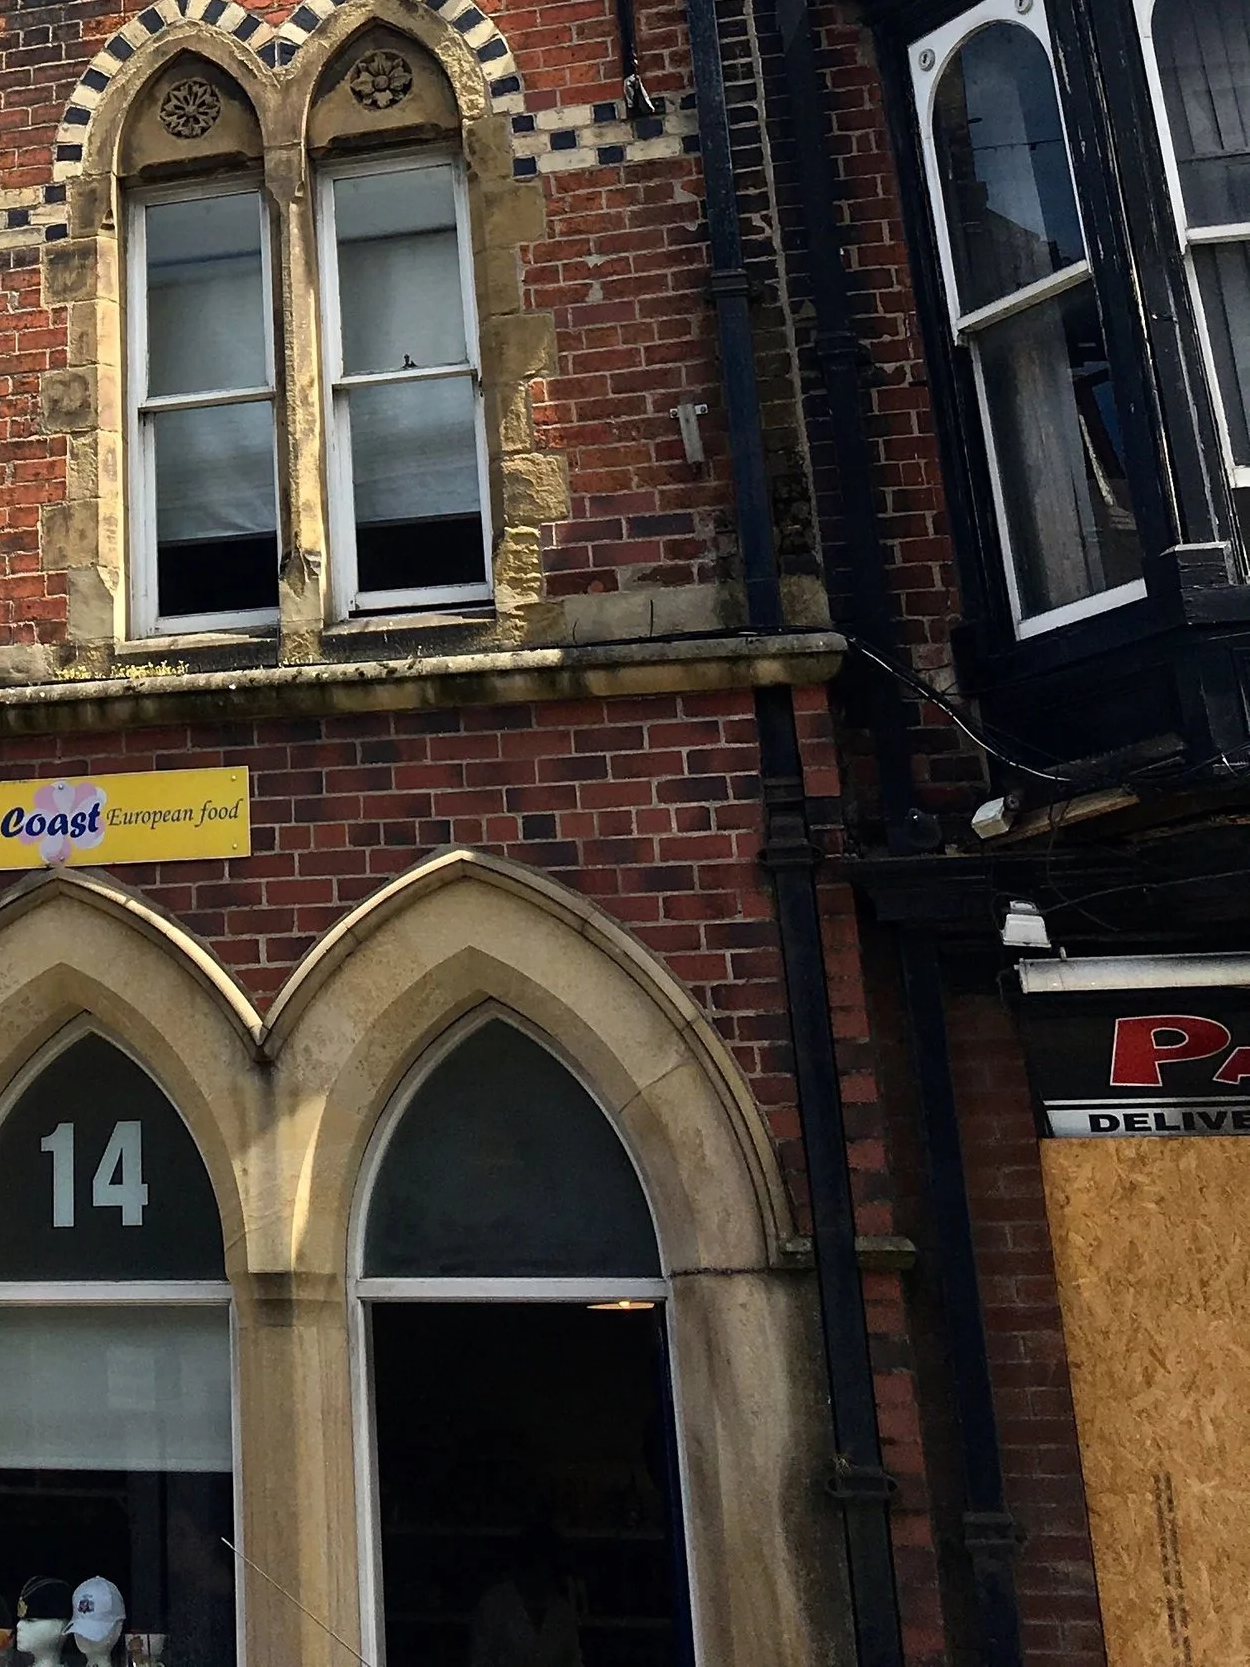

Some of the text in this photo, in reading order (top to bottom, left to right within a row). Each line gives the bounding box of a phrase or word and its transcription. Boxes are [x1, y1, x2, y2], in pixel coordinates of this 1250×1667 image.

[0, 802, 101, 839] Coast
[106, 807, 194, 830] European
[194, 798, 244, 828] food
[40, 1120, 149, 1228] 14
